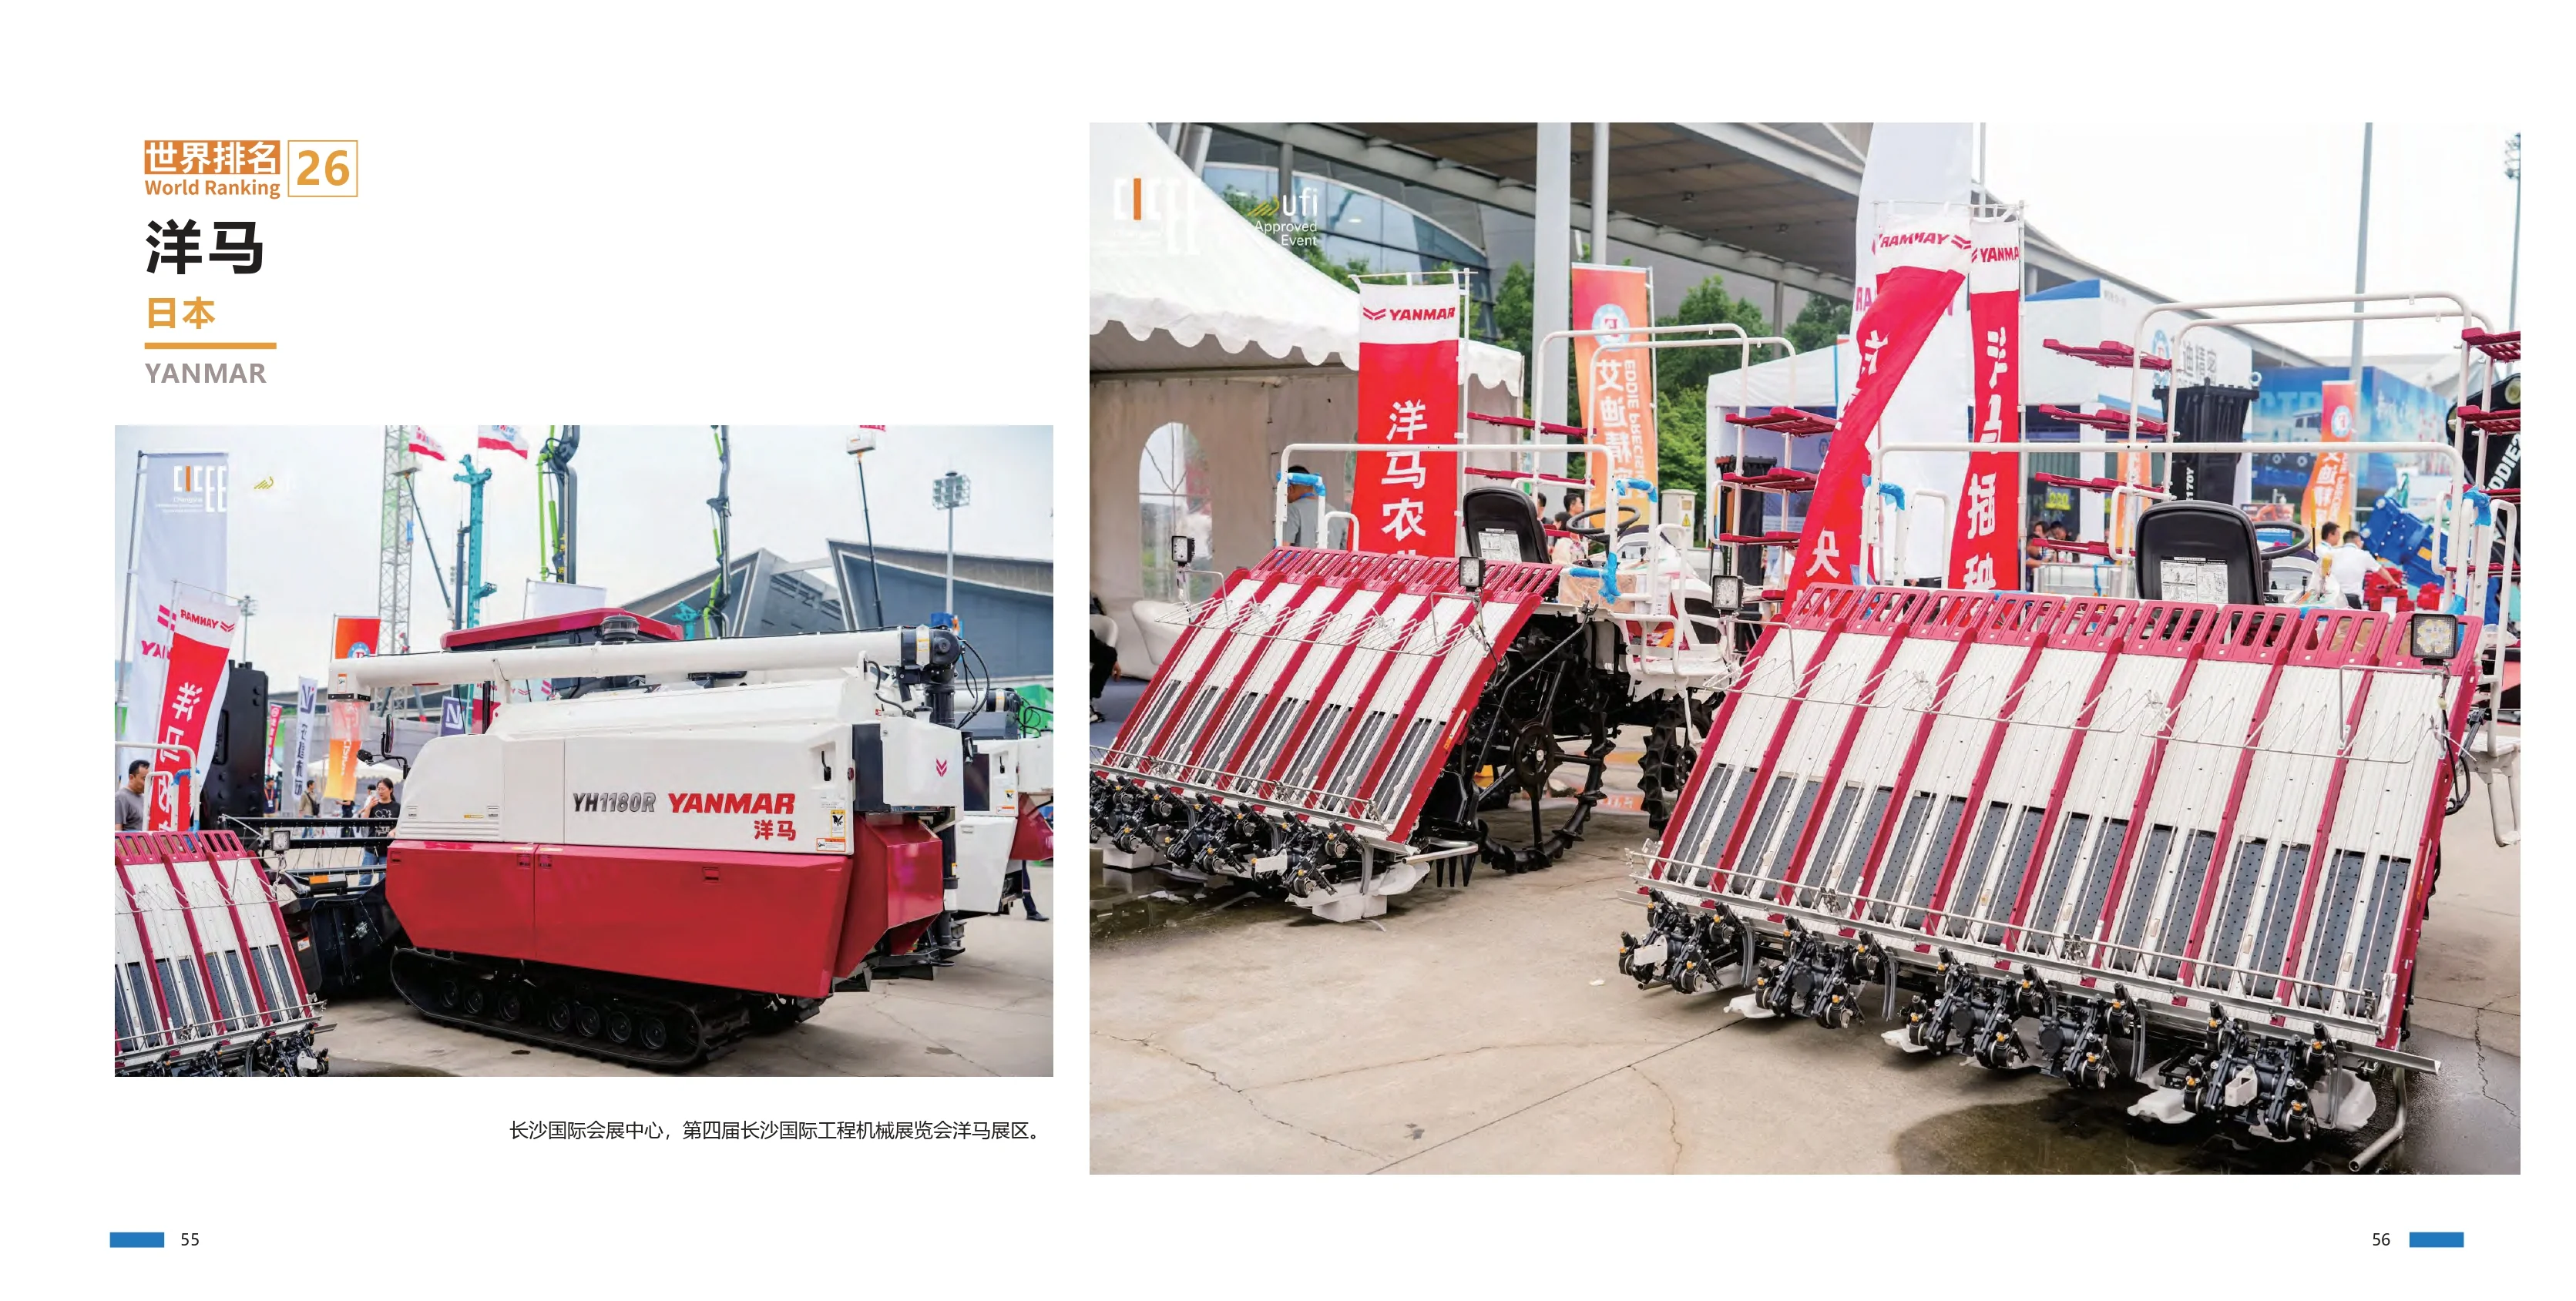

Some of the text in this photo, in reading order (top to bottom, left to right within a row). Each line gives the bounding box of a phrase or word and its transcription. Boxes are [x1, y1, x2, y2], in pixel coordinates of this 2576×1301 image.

[146, 142, 276, 173] 世界排名
[297, 150, 350, 186] 26
[145, 179, 280, 200] World Ranking
[146, 219, 264, 274] 洋马
[148, 297, 216, 330] 日本
[145, 364, 267, 383] YANMAR
[1381, 398, 1428, 558] 洋马农
[573, 792, 656, 813] YH1180R
[668, 793, 796, 815] YANMAR
[754, 820, 797, 841] 洋马
[181, 1232, 200, 1246] 55
[2373, 1232, 2391, 1246] 56
